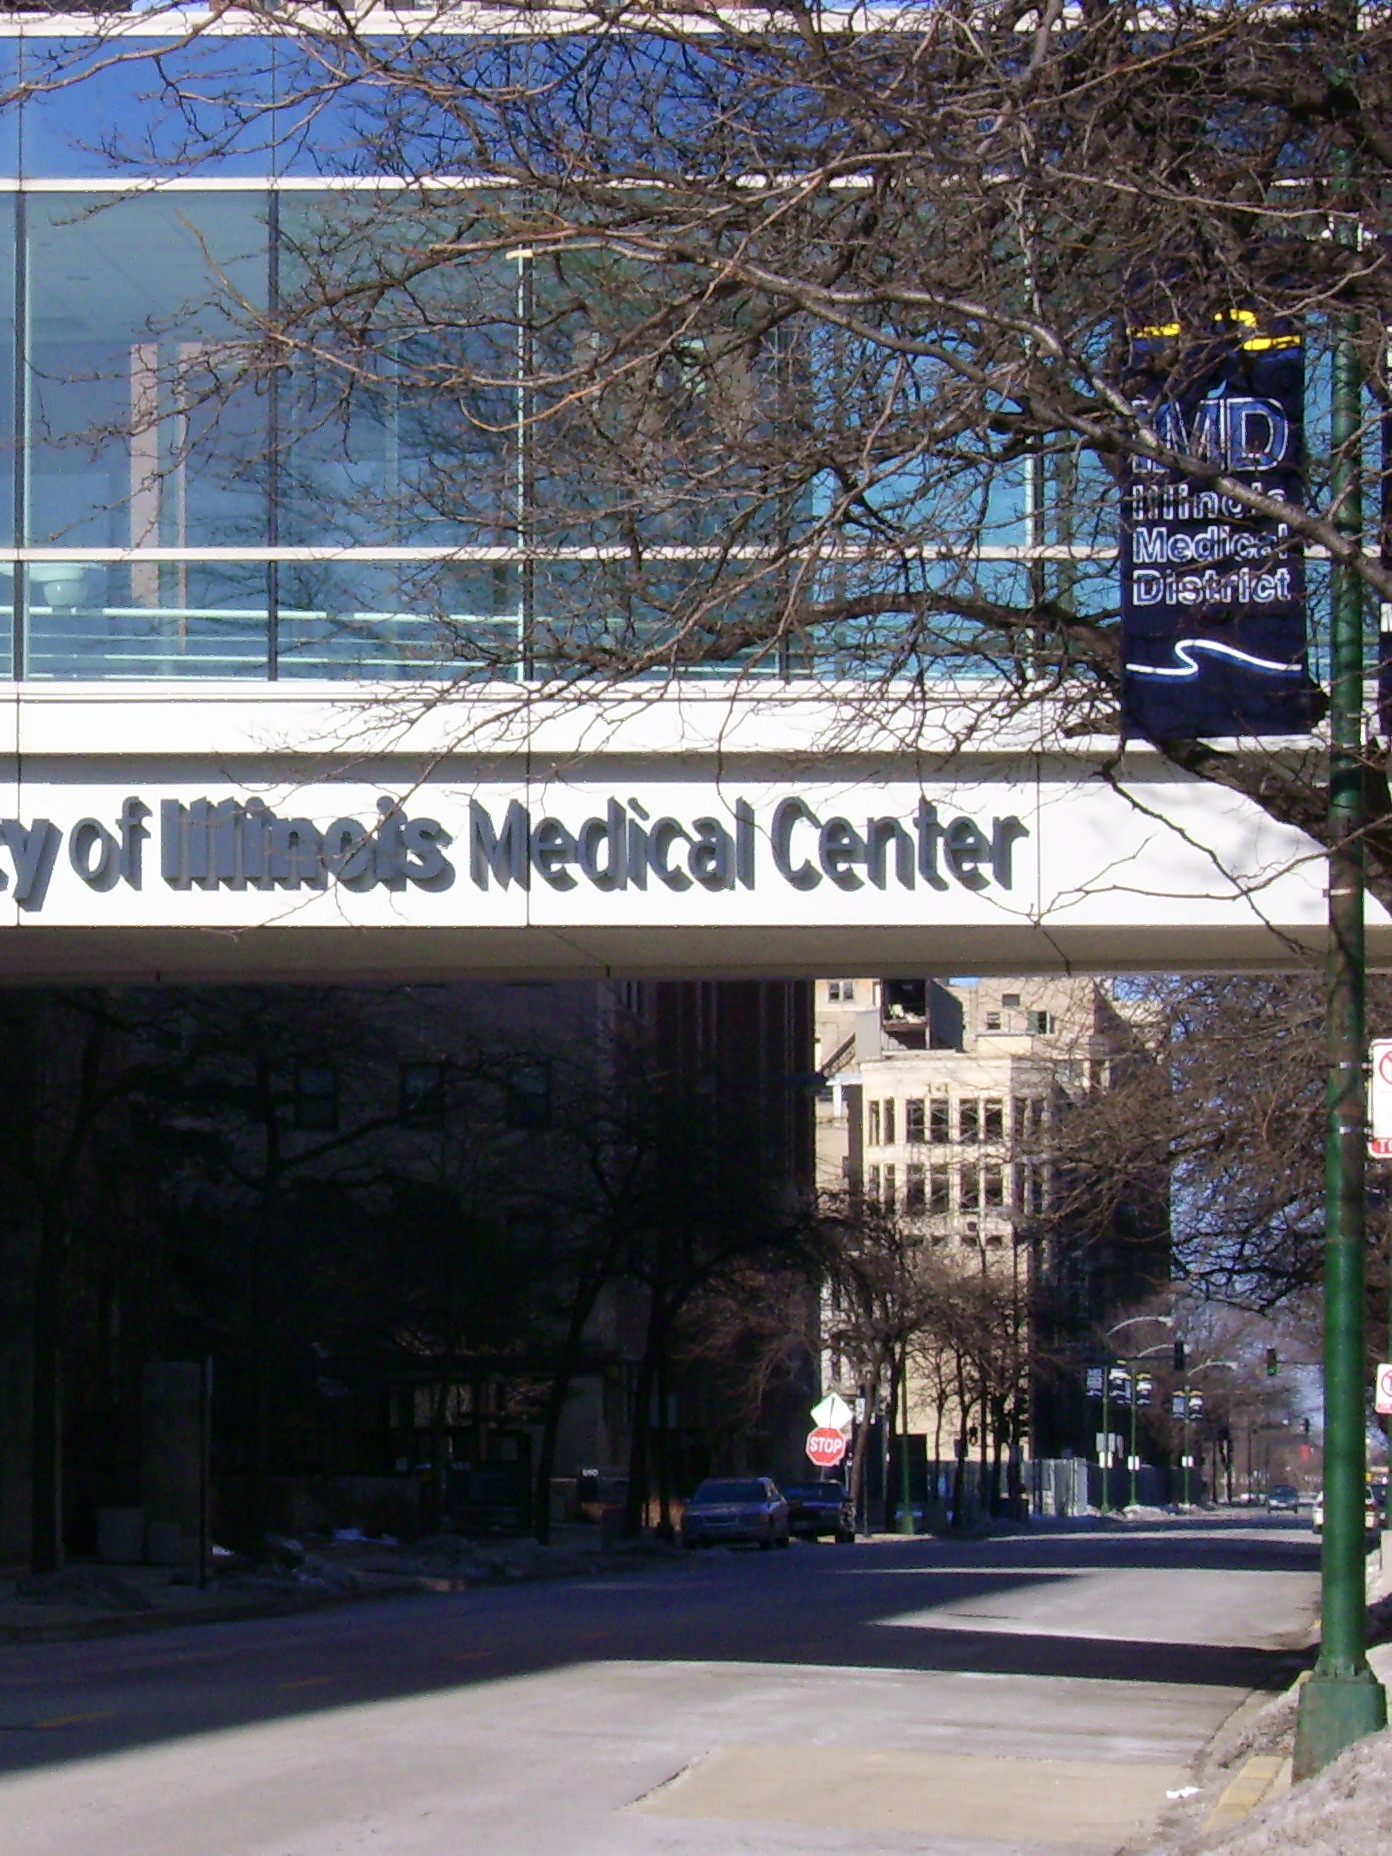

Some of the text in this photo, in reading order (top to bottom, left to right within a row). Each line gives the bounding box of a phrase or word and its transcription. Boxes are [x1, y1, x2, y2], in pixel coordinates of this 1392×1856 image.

[1131, 522, 1290, 564] Medical
[1131, 566, 1292, 606] District
[69, 795, 153, 892] of
[160, 795, 457, 893] Illinois
[468, 796, 755, 893] Medical
[770, 796, 1030, 893] Center
[809, 1436, 843, 1454] STOP
